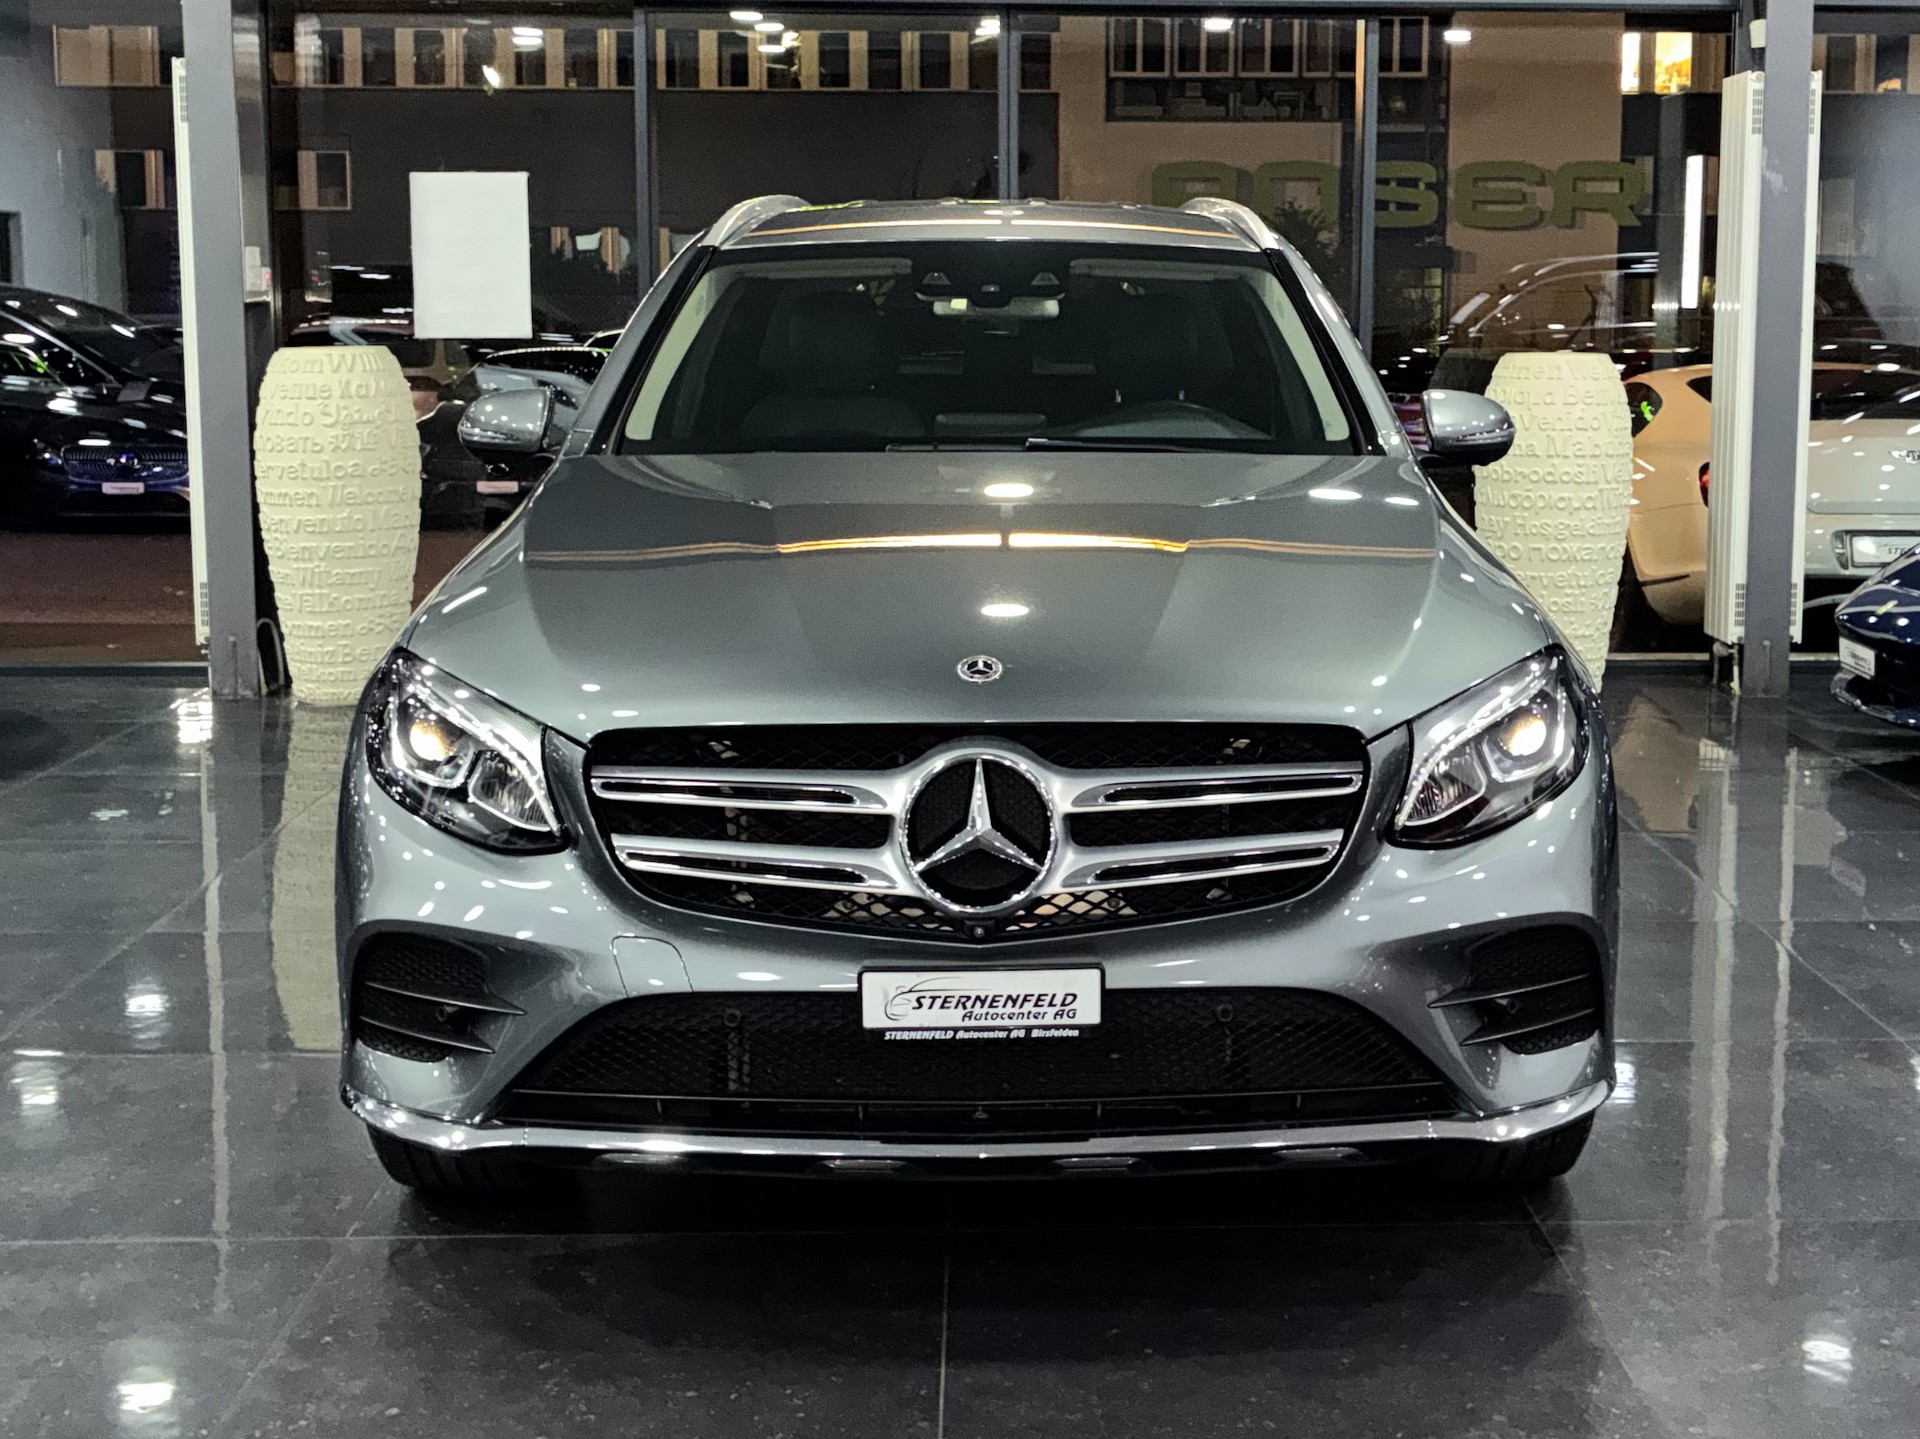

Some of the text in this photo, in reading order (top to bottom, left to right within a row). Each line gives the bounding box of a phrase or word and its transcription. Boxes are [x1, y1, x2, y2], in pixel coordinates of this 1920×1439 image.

[912, 992, 1078, 1010] STERNENFELD
[961, 1008, 1077, 1023] Autocenter AG
[884, 1028, 1079, 1041] STERNENFELD Autocenter AG Birsfelden
